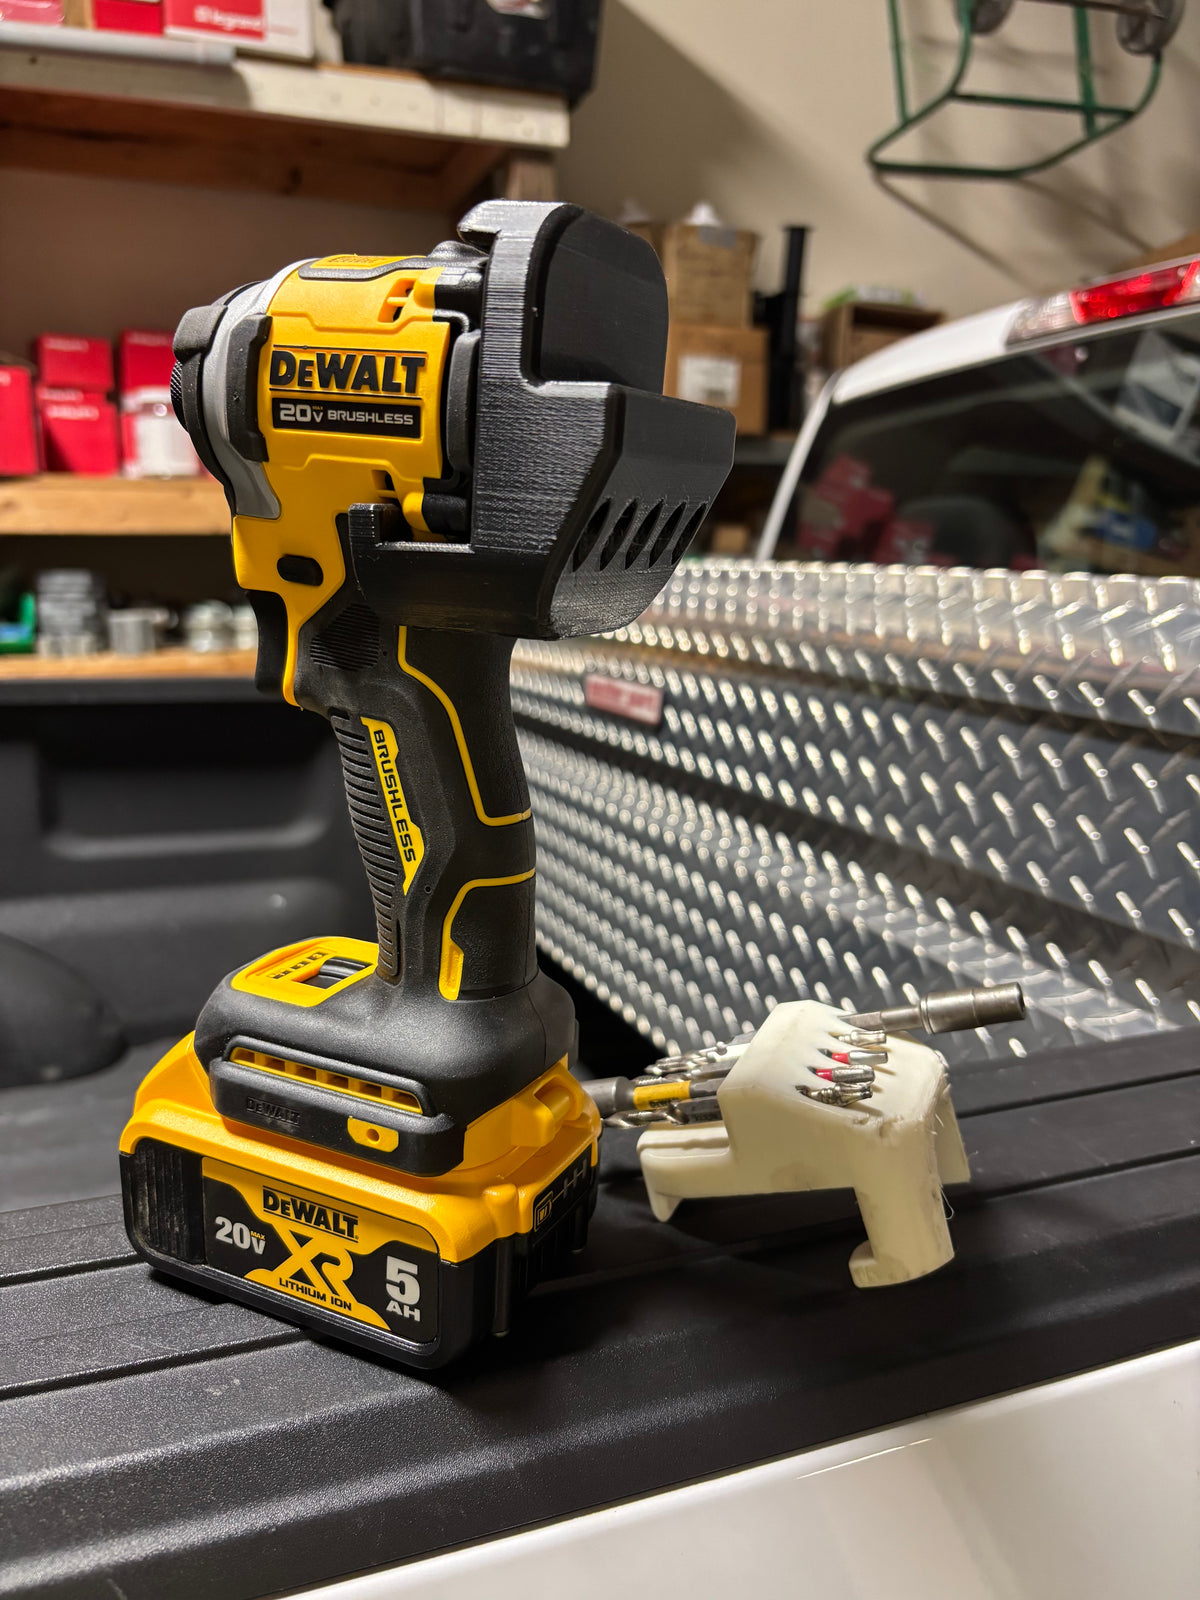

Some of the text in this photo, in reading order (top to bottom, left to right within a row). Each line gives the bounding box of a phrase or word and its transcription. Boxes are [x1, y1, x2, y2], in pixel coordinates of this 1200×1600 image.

[327, 409, 414, 425] BRUSHLESS
[374, 730, 416, 862] BRUSHLESS
[279, 1277, 352, 1311] LITHIUM ION
[386, 1255, 420, 1305] 5
[386, 1300, 421, 1322] AH
